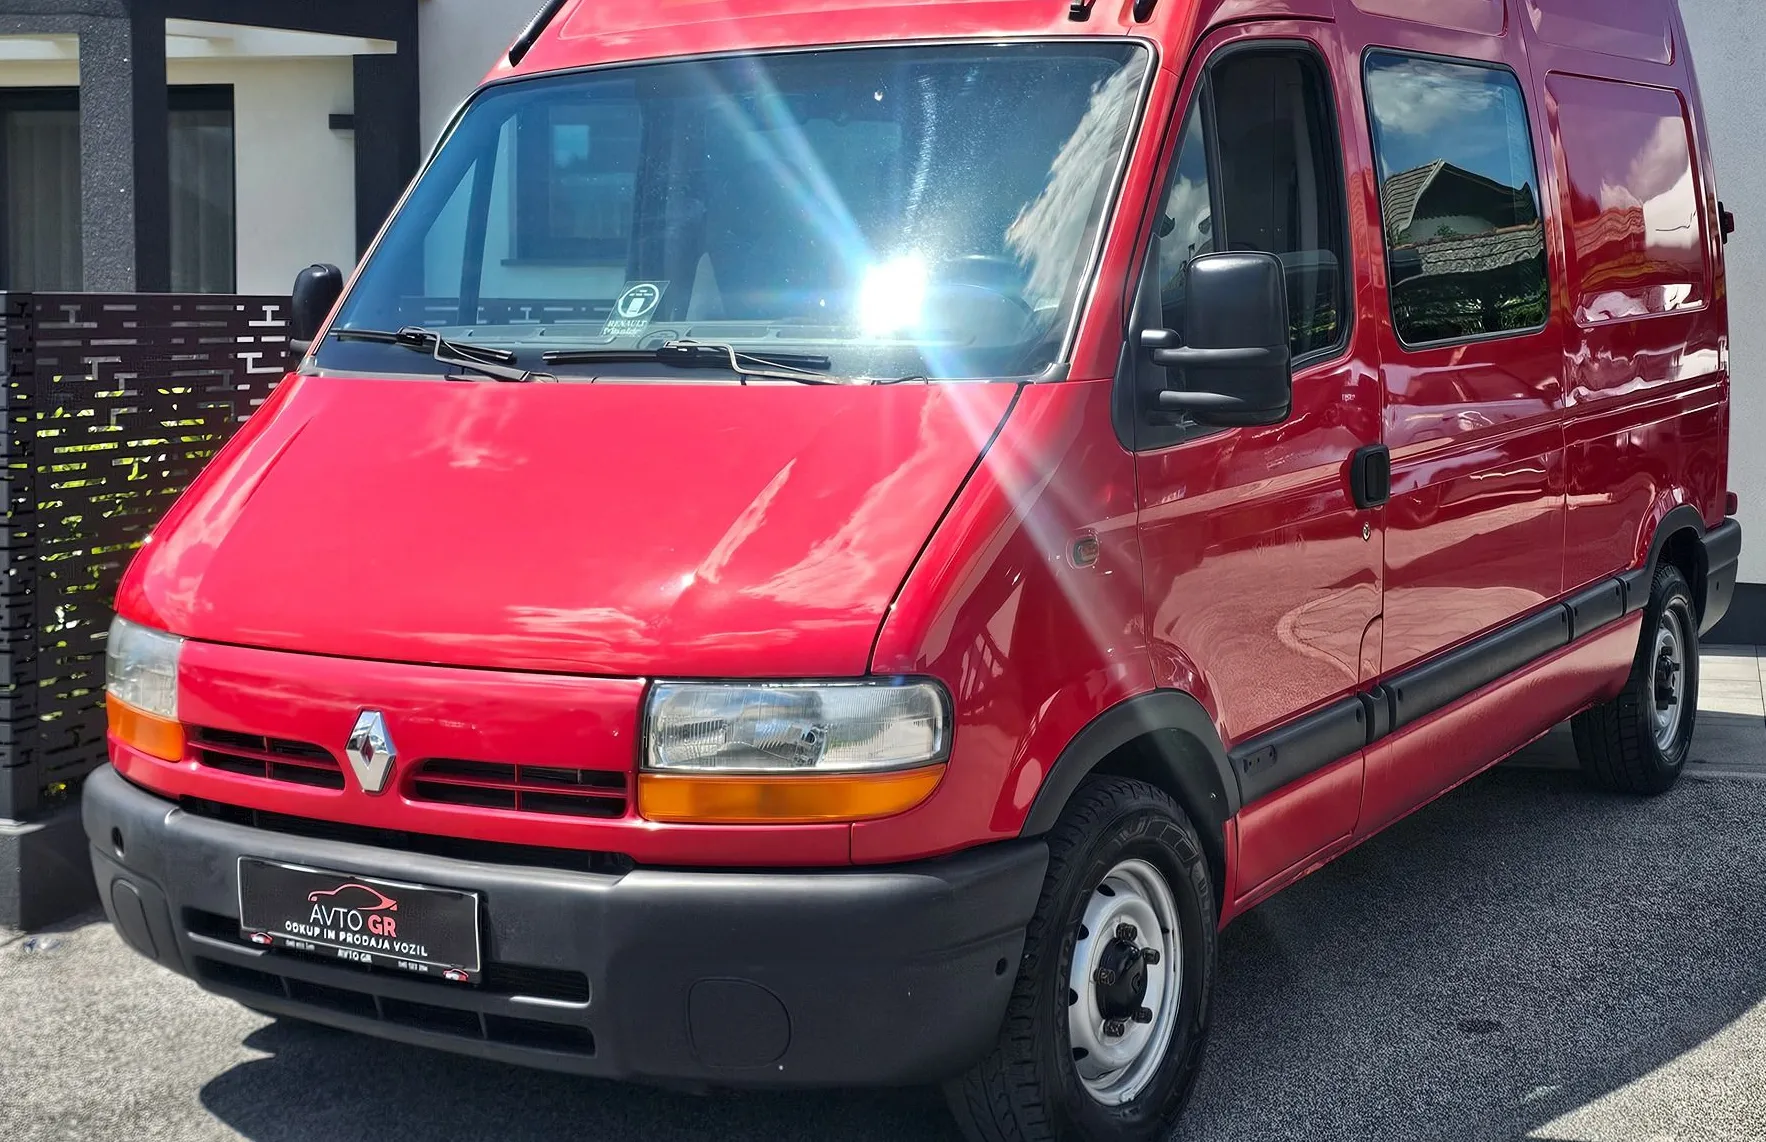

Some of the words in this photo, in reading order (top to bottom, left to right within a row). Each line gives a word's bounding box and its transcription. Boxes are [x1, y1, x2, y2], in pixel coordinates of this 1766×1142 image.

[285, 920, 320, 937] ODKUP
[323, 928, 336, 941] IN
[339, 930, 390, 950] PRODAJA
[393, 941, 428, 957] VOZIL
[309, 903, 363, 931] AVTO
[367, 915, 397, 938] GR
